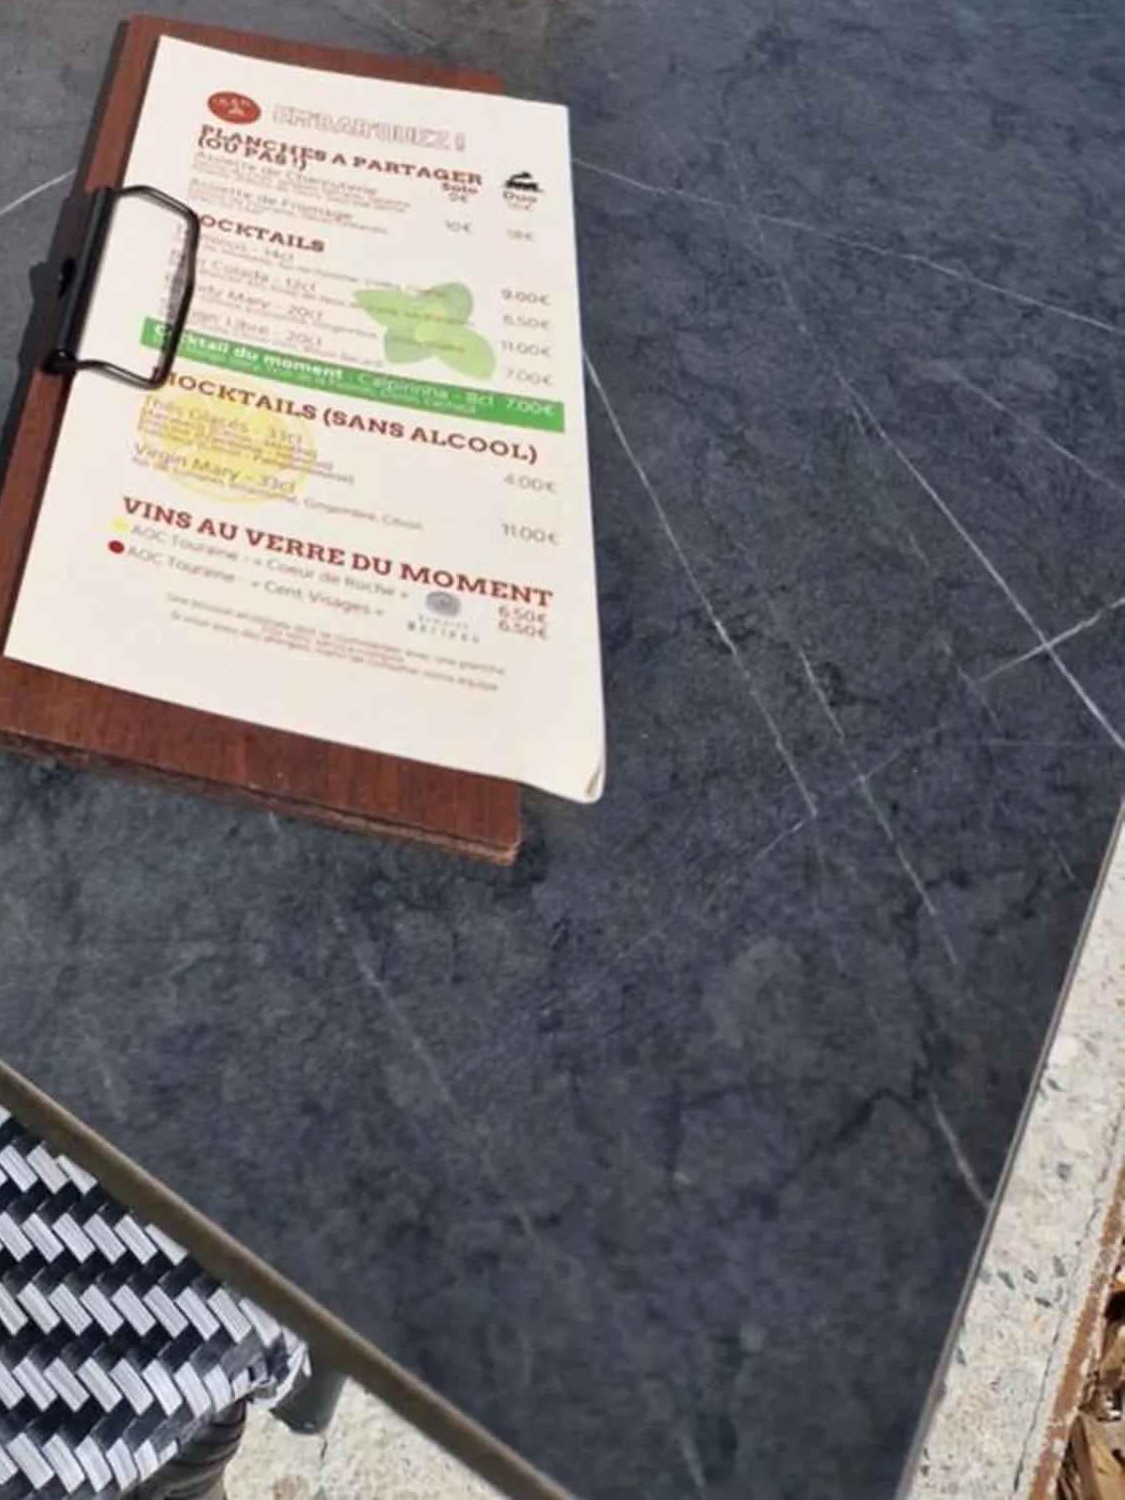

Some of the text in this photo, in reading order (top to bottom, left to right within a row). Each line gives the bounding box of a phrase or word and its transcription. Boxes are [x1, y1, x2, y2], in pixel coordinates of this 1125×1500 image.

[199, 123, 328, 163] PLANCHES
[352, 155, 484, 187] PARTAGER
[199, 213, 326, 254] OCKTAILS
[262, 353, 345, 380] moment
[323, 406, 406, 439] (SANS
[409, 425, 540, 466] ALCOOL)
[123, 495, 554, 609] VINS AU VERRE DU MOMENT
